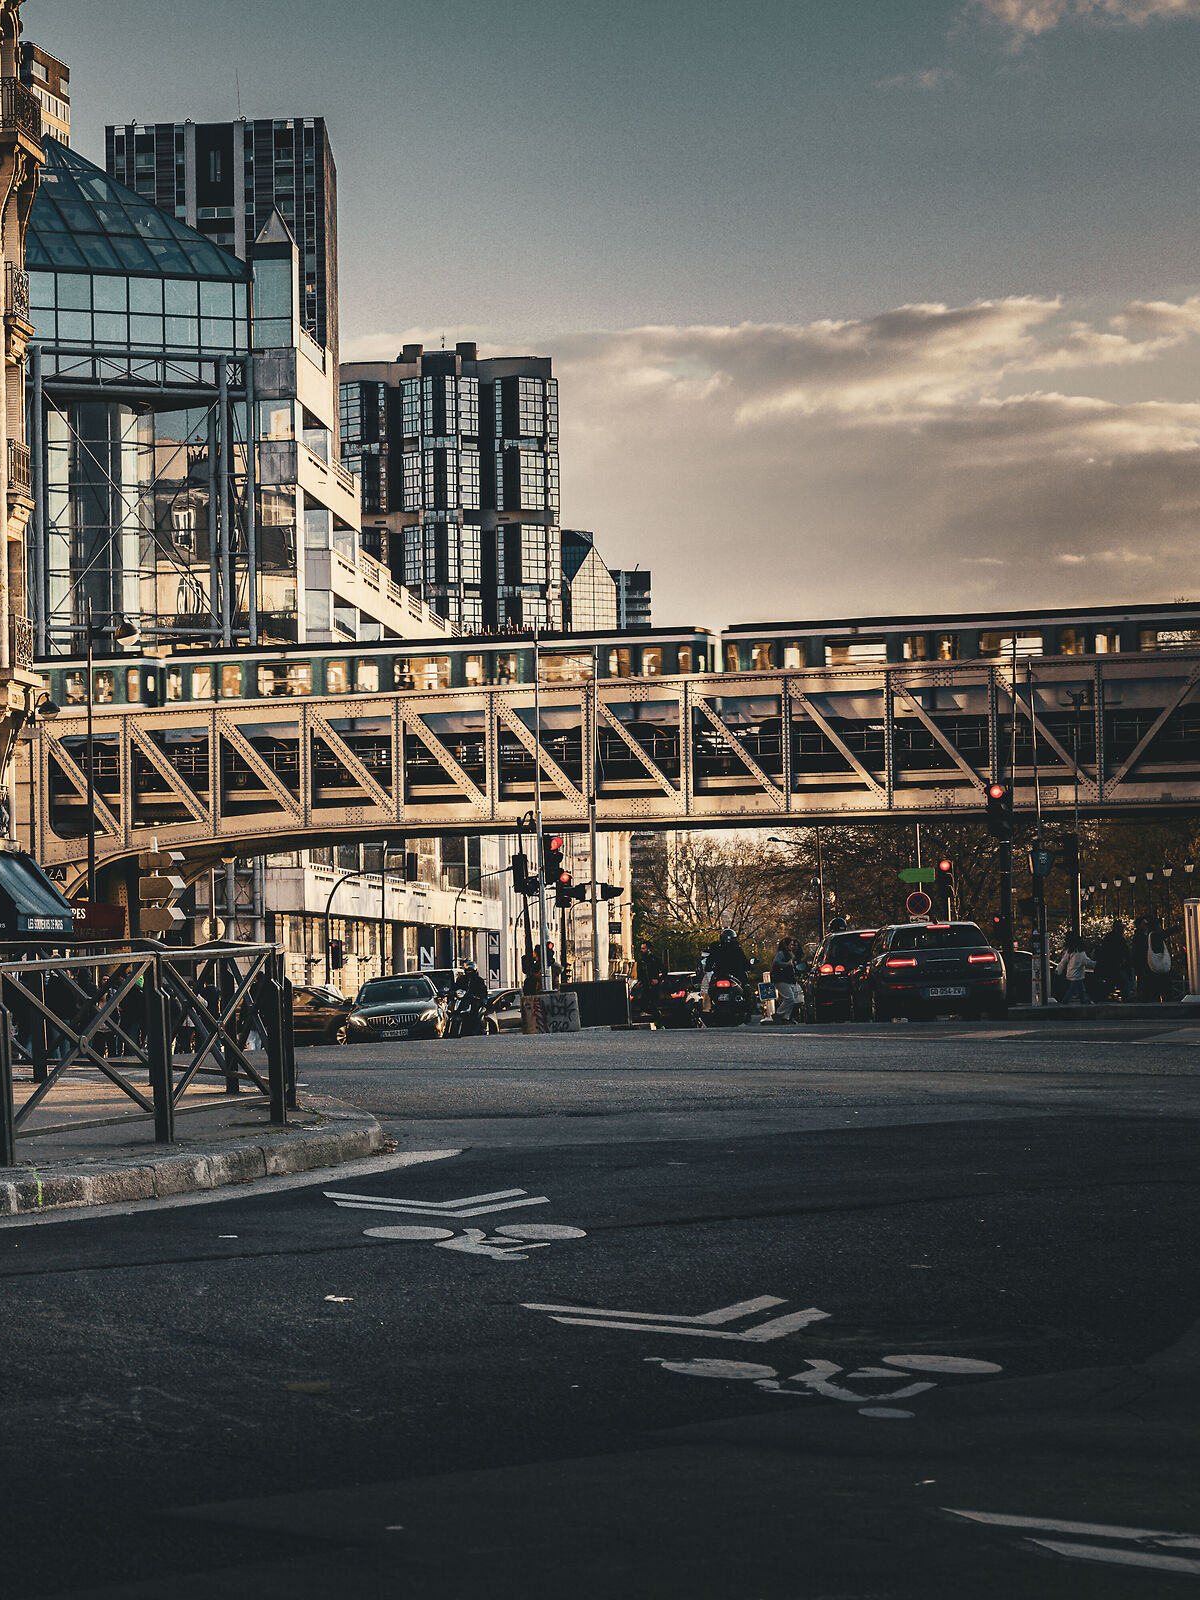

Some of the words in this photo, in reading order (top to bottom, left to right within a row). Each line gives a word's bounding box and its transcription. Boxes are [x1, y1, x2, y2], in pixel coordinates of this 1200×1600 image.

[42, 868, 64, 880] ZA
[71, 908, 86, 919] PES
[420, 946, 434, 965] N
